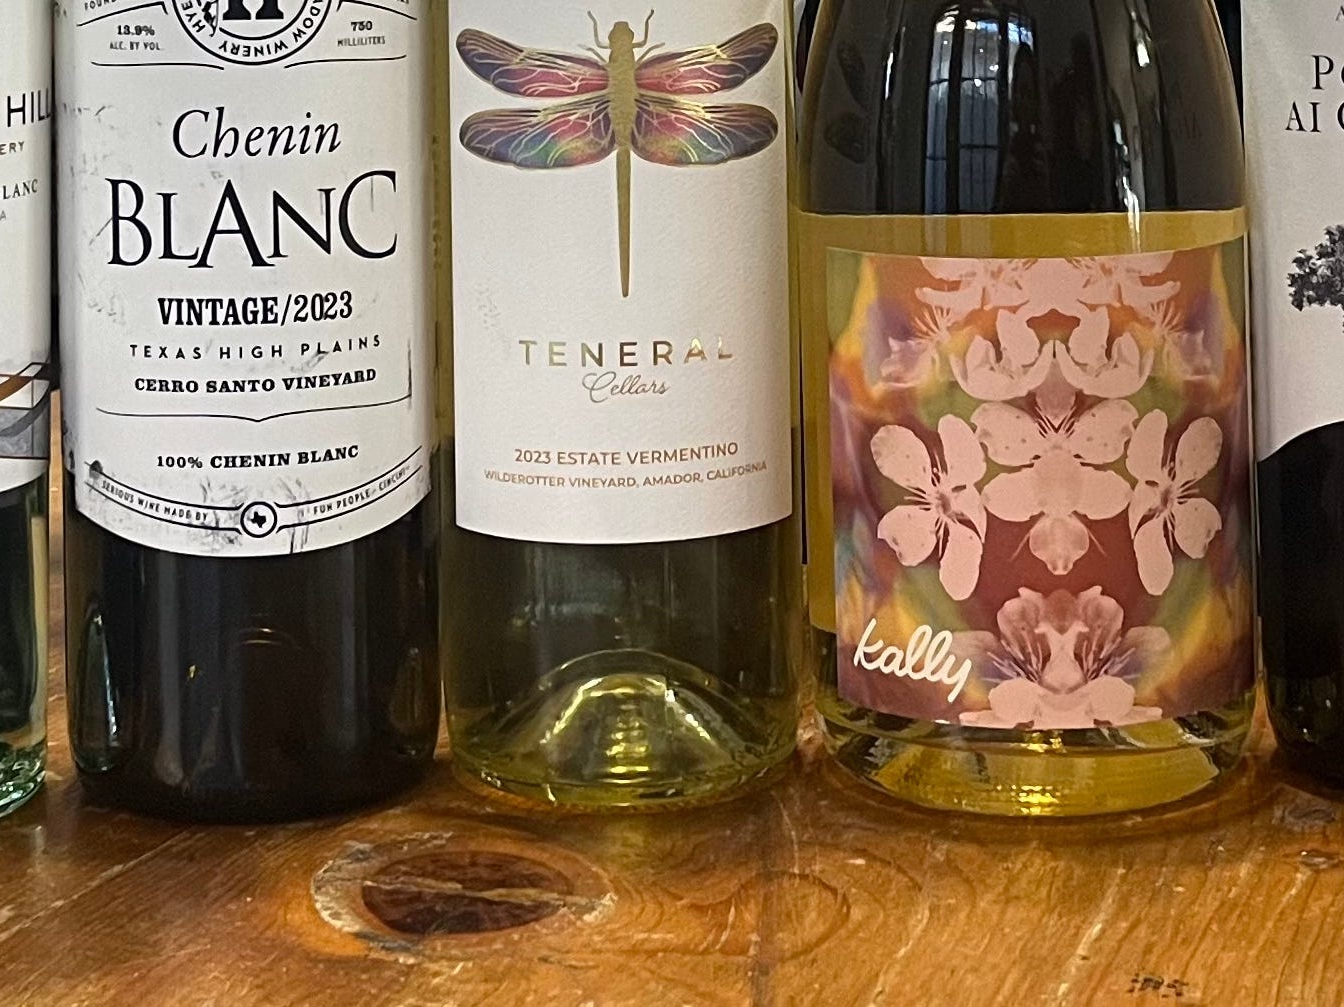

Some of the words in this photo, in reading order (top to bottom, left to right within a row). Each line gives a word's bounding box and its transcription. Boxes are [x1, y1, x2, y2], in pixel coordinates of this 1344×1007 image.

[181, 0, 206, 33] HYE
[218, 40, 288, 58] WINERY
[7, 87, 52, 128] HILL
[1284, 99, 1322, 133] AI
[171, 106, 342, 159] Chenin
[105, 169, 399, 269] BLANC
[157, 291, 354, 327] VINTAGE/2023
[129, 343, 203, 360] TEXAS
[219, 344, 283, 360] HIGH
[301, 334, 382, 356] PLAINS
[518, 336, 734, 368] TENERAL
[134, 377, 199, 394] CERRO
[206, 377, 276, 394] SANTO
[281, 368, 377, 391] VINEYARD
[582, 370, 671, 403] Cellars
[156, 455, 203, 469] 100%
[210, 453, 291, 469] CHENIN
[297, 445, 359, 465] BLANC
[514, 448, 551, 465] 2023
[557, 451, 622, 466] ESTATE
[626, 441, 739, 465] VERMENTINO
[483, 469, 566, 488] WILDEROTTER
[568, 476, 640, 489] VINEYARD,
[642, 472, 705, 488] AMADOR,
[706, 461, 768, 482] CALIFORNIA
[101, 479, 135, 505] SERIOUS
[138, 496, 161, 513] WINE
[163, 506, 192, 520] MADE
[195, 512, 208, 522] BY
[313, 503, 333, 516] FUN
[336, 488, 371, 509] PEOPLE
[853, 617, 973, 703] kally
